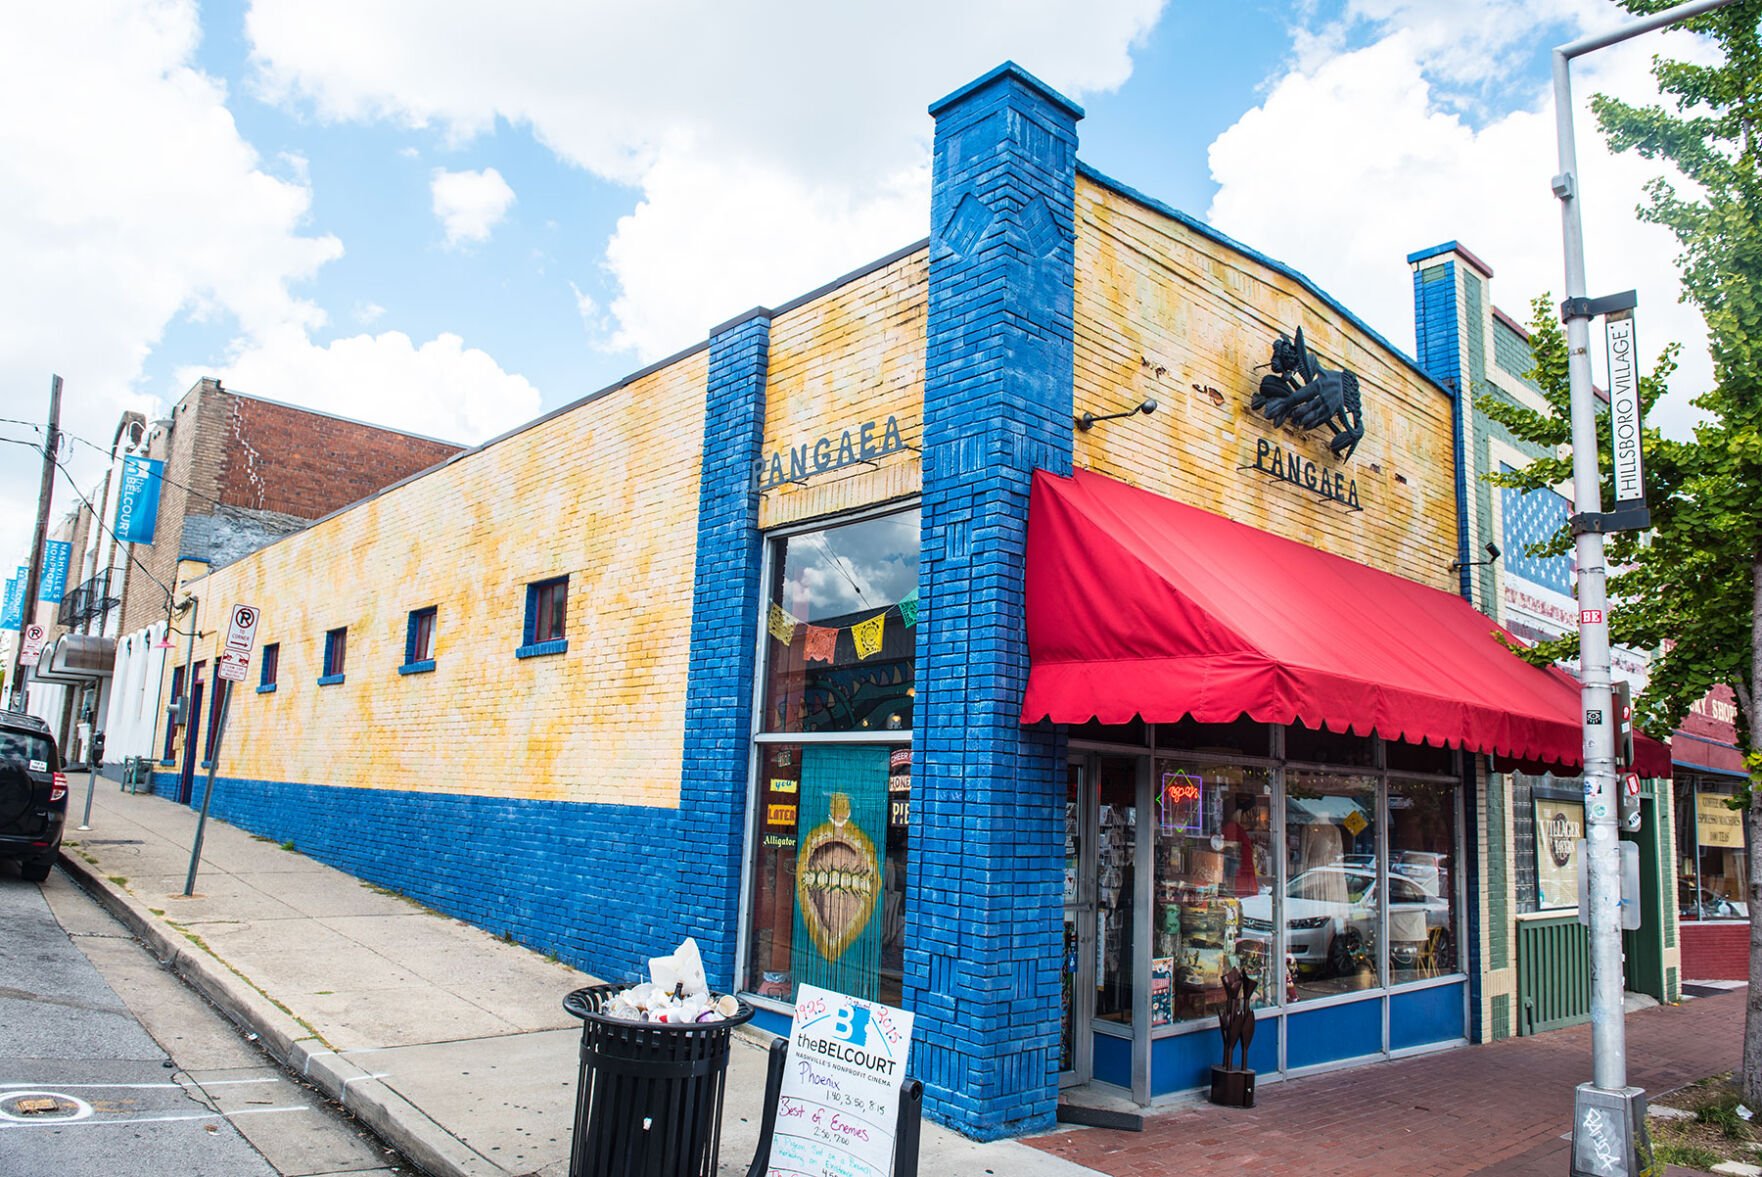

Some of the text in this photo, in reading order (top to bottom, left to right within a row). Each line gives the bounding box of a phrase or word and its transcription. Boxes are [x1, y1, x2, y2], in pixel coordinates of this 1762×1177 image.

[1612, 330, 1637, 492] HILLSBORO VILLAGE
[751, 415, 902, 491] PANGAEA
[1257, 438, 1361, 509] PANGAEA
[118, 476, 137, 537] BELCOURT
[44, 542, 58, 593] NONPROFIT
[53, 543, 68, 600] NASHVILLE'S
[1582, 611, 1601, 623] BE
[775, 780, 792, 790] you
[767, 808, 795, 821] LATER
[763, 835, 797, 847] Alligator
[1540, 819, 1581, 850] VILLAGER
[795, 997, 826, 1024] 1925
[877, 1006, 903, 1044] 2015
[796, 1051, 892, 1088] NASHVILLE'S NONPROFIT CINEMA
[798, 1060, 841, 1091] Phoenix
[778, 1096, 870, 1142] Best of Enemies
